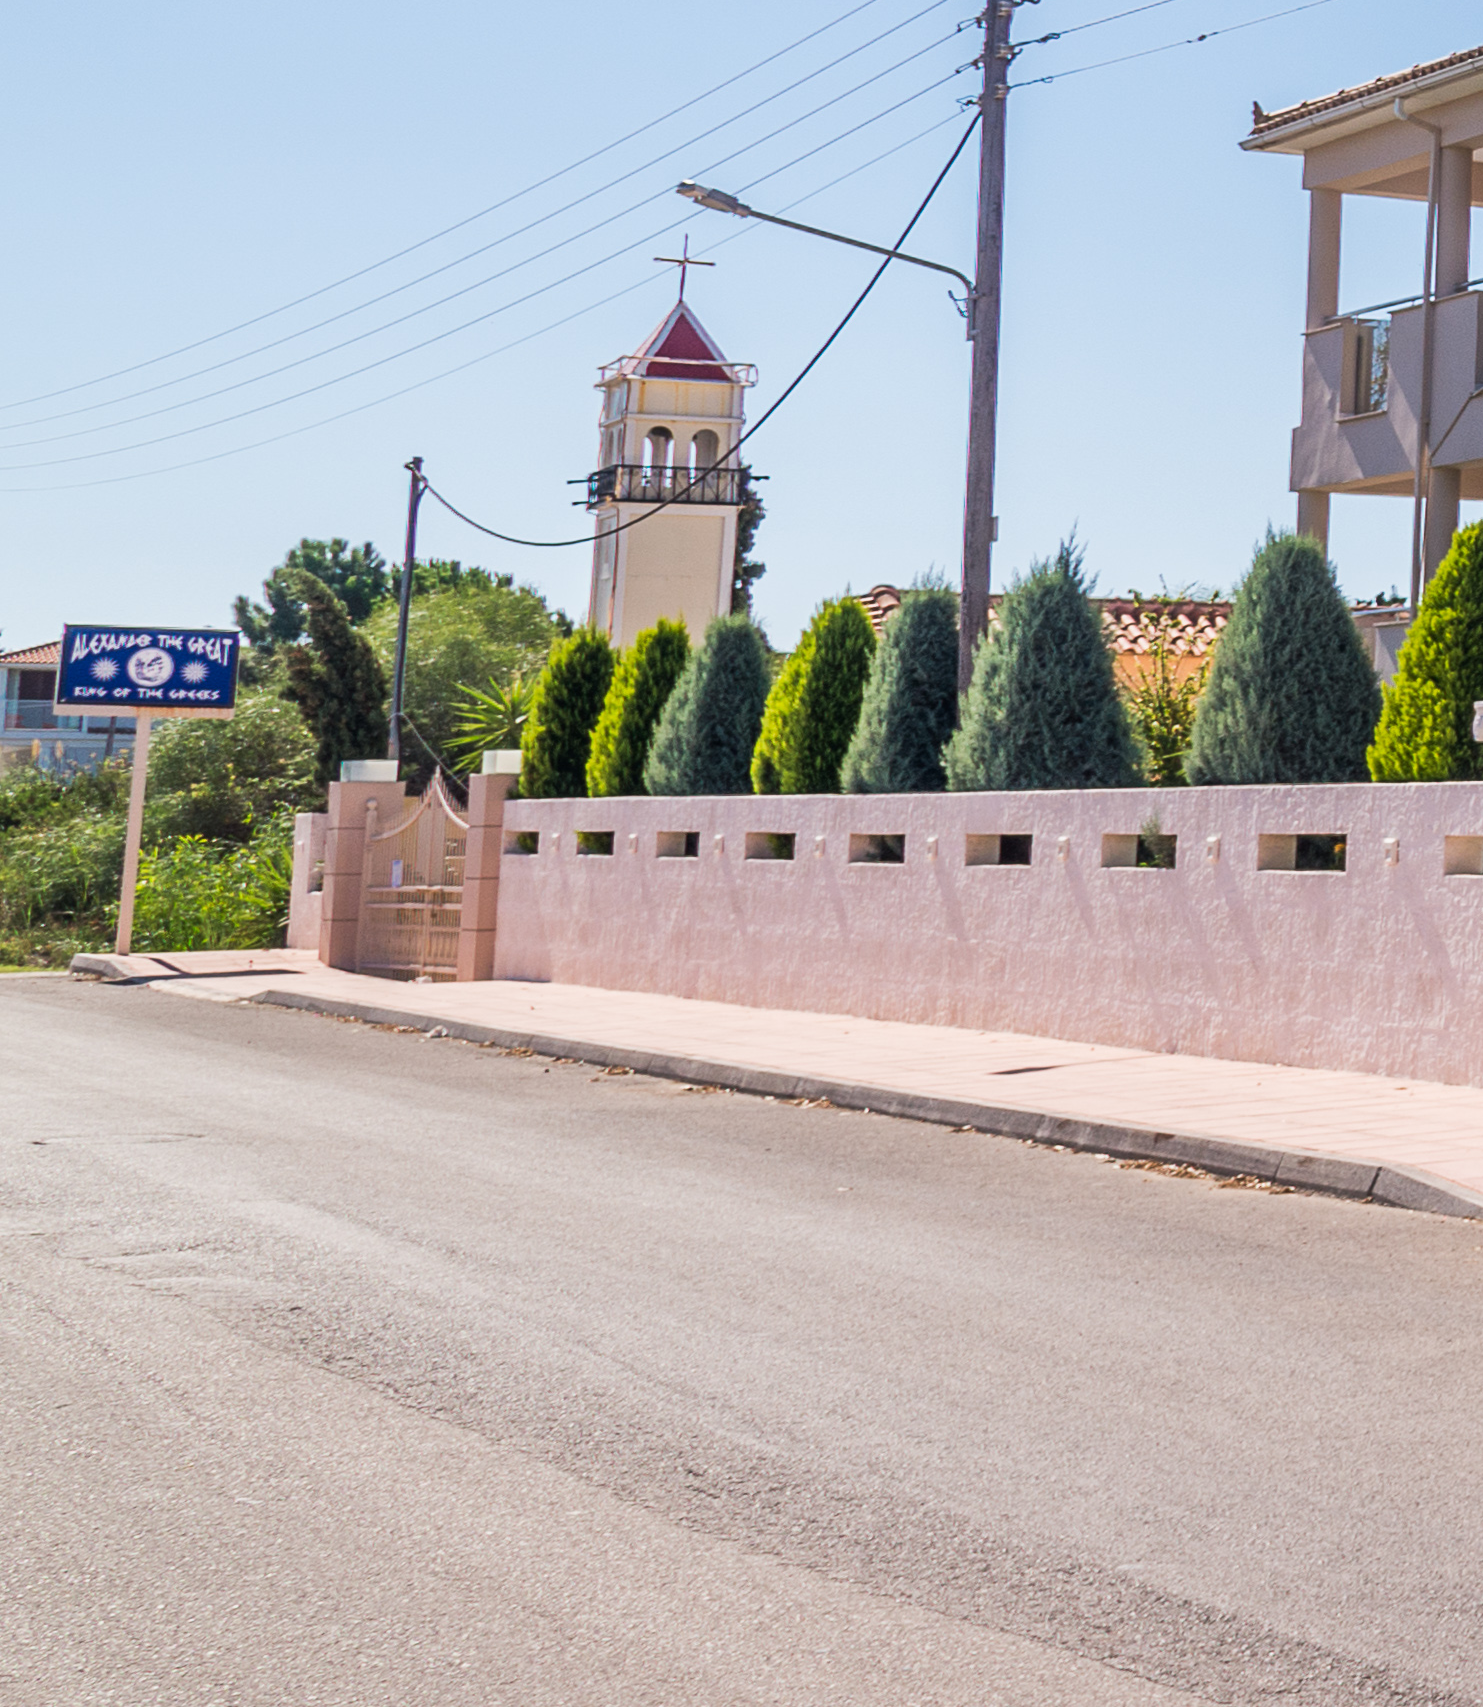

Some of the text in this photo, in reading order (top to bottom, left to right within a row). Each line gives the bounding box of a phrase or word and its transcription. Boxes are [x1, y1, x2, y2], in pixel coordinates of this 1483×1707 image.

[70, 632, 234, 667] ALEXANDER THE GREAT
[74, 686, 221, 700] KING OF THE GREEKS
